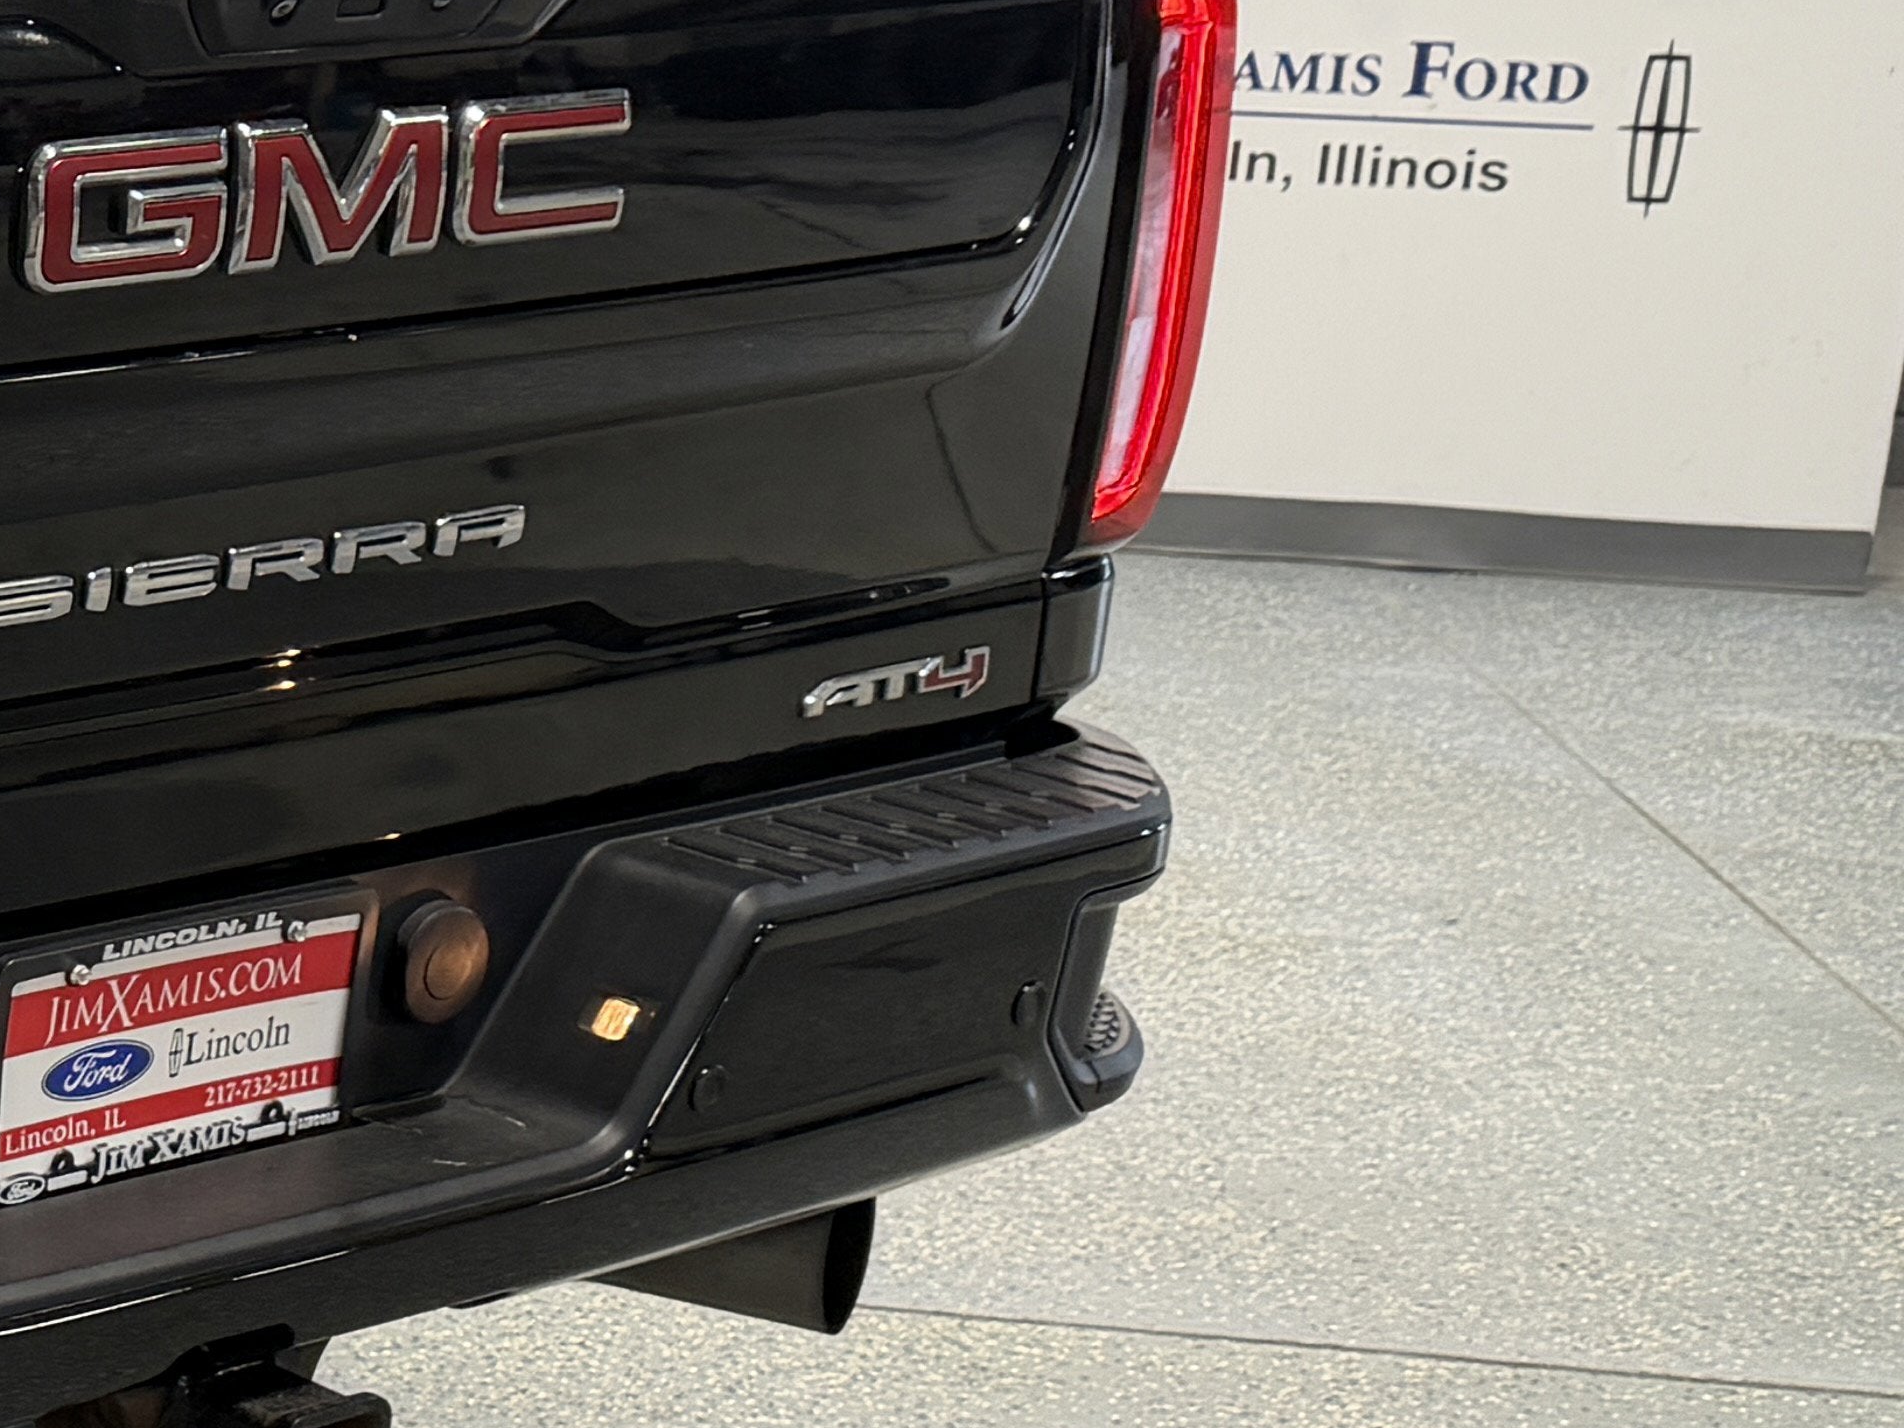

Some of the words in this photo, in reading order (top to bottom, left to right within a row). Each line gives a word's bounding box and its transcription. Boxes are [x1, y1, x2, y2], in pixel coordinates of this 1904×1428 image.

[1232, 49, 1383, 97] AMIS
[1401, 39, 1590, 104] FORD
[23, 86, 631, 294] GMC
[1316, 143, 1510, 193] Illinois
[801, 645, 991, 718] AT4
[254, 911, 284, 931] IL
[44, 952, 303, 1047] JIMXAMIS.COM
[182, 1015, 291, 1067] Lincoln
[63, 1049, 133, 1093] Ford
[204, 1066, 320, 1107] 217-732-2111
[5, 1116, 96, 1156] Lincoln,
[103, 1107, 127, 1131] IL
[91, 1143, 147, 1184] JIM
[151, 1121, 248, 1165] XAMIS
